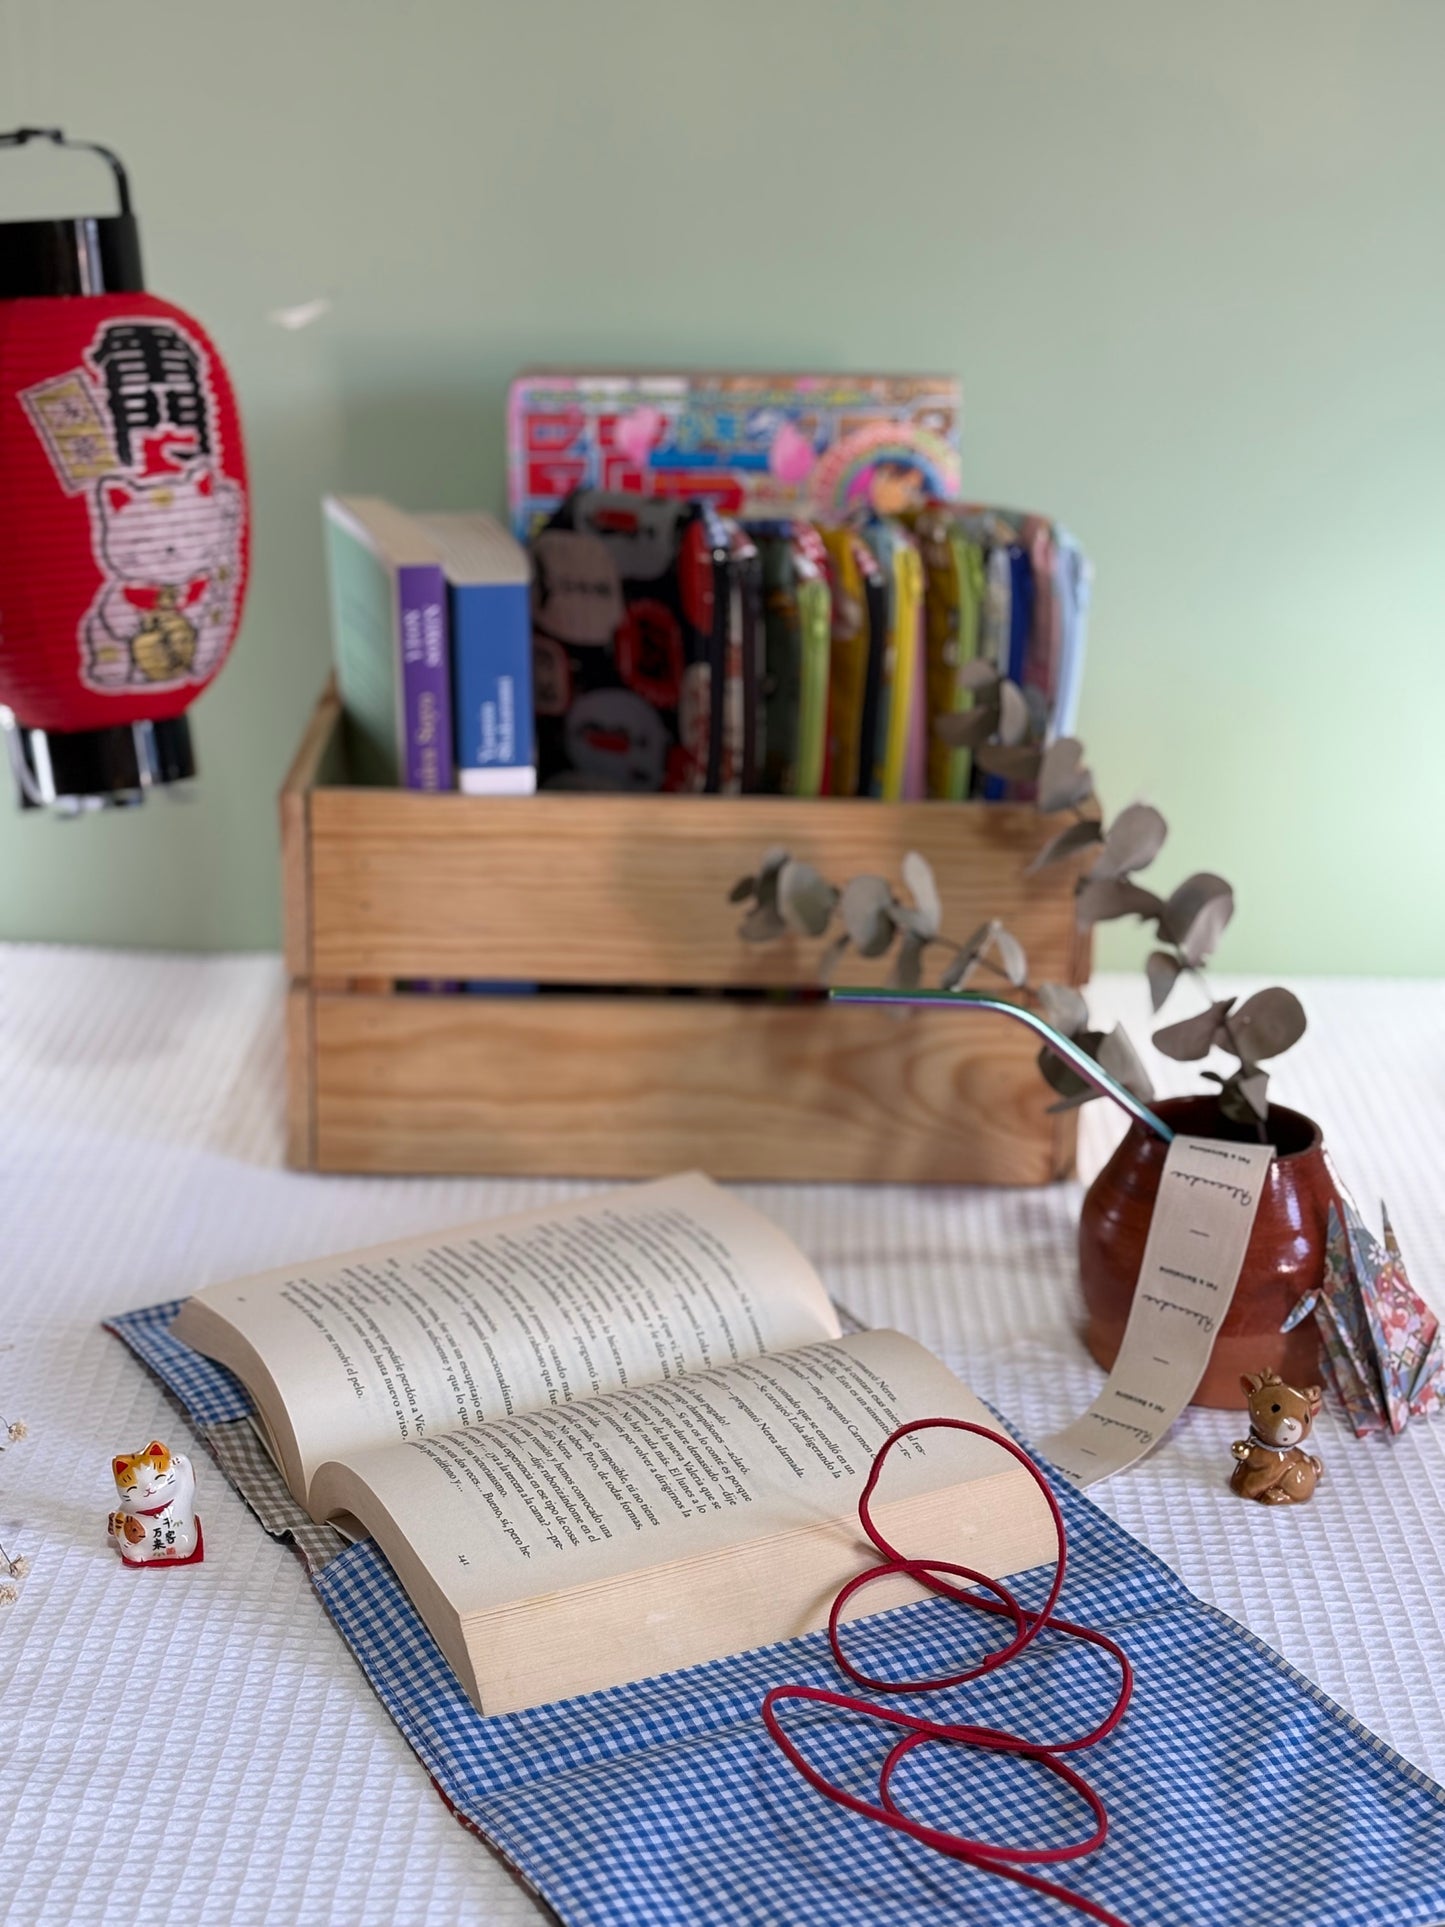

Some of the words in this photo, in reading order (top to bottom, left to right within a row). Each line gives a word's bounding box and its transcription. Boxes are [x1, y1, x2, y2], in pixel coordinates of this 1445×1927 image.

[696, 1331, 709, 1354] Lola
[346, 1367, 358, 1376] el
[528, 1336, 546, 1368] rabioso
[540, 1369, 553, 1387] que
[548, 1389, 558, 1405] fue
[548, 1344, 567, 1379] cuando
[562, 1381, 573, 1402] más
[607, 1335, 622, 1366] hiciera
[618, 1368, 628, 1389] mu-
[661, 1361, 671, 1381] una
[674, 1355, 687, 1377] Tiró
[347, 1376, 364, 1398] pelo.
[446, 1374, 460, 1392] que
[453, 1348, 463, 1360] un
[459, 1361, 480, 1408] escupitajo
[475, 1409, 484, 1423] en
[483, 1342, 514, 1416] emocionadísima
[591, 1380, 602, 1395] in-
[373, 1354, 388, 1376] hasta
[384, 1377, 400, 1407] nuevo
[395, 1410, 408, 1440] aviso.
[381, 1345, 404, 1371] pedirle
[395, 1372, 416, 1405] perdón
[414, 1414, 425, 1436] Víc-
[455, 1393, 465, 1404] lo
[856, 1396, 867, 1406] un
[457, 1406, 470, 1426] que
[682, 1419, 693, 1428] no
[700, 1402, 730, 1426] pegado!
[817, 1395, 850, 1424] preguntó
[847, 1424, 872, 1453] Carmen
[849, 1372, 873, 1394] contara
[871, 1394, 885, 1407] esas
[912, 1442, 925, 1455] res-
[652, 1426, 664, 1434] de
[659, 1433, 670, 1441] la
[686, 1404, 724, 1443] champiñones
[724, 1445, 750, 1475] —aclaró.
[691, 1428, 701, 1437] os
[697, 1436, 708, 1445] lo
[764, 1392, 792, 1417] carcajeó
[787, 1416, 805, 1434] Lola
[801, 1434, 834, 1470] aligerando
[831, 1470, 842, 1479] la
[775, 1385, 800, 1409] contado
[796, 1408, 812, 1421] que
[808, 1421, 818, 1429] se
[815, 1429, 841, 1454] enrolló
[836, 1454, 847, 1464] en
[843, 1464, 855, 1475] un
[660, 1417, 676, 1429] que
[673, 1429, 690, 1444] dure
[686, 1445, 719, 1482] demasiado
[718, 1483, 737, 1505] —dije
[664, 1441, 684, 1461] nueva
[705, 1445, 726, 1465] conté
[757, 1422, 777, 1444] Nerea
[775, 1445, 804, 1478] alarmada.
[472, 1455, 507, 1497] victorianismo.
[598, 1448, 628, 1484] imposible,
[618, 1433, 636, 1444] por
[633, 1445, 653, 1467] volver
[654, 1473, 684, 1509] dirigirnos
[681, 1509, 692, 1518] la
[629, 1420, 643, 1432] hay
[640, 1433, 658, 1450] nada
[654, 1450, 670, 1467] más.
[668, 1467, 682, 1477] El
[675, 1477, 695, 1498] lunes
[696, 1504, 707, 1514] lo
[683, 1461, 704, 1486] Valeria
[721, 1466, 731, 1474] es
[504, 1471, 524, 1493] tercera
[582, 1451, 599, 1471] Pero,
[597, 1471, 609, 1480] de
[604, 1480, 623, 1501] todas
[620, 1501, 642, 1530] formas,
[625, 1483, 638, 1493] tú
[725, 1475, 752, 1501] porque
[523, 1496, 534, 1505] la
[553, 1462, 574, 1485] hemos
[571, 1485, 602, 1523] convocado
[599, 1523, 612, 1538] una
[631, 1493, 644, 1503] no
[699, 1486, 715, 1501] que
[482, 1492, 502, 1518] Bueno,
[528, 1504, 551, 1526] cama?
[529, 1480, 540, 1489] en
[536, 1489, 548, 1500] ese
[544, 1499, 559, 1515] tipo
[555, 1515, 567, 1525] de
[562, 1525, 580, 1546] cosas.
[541, 1470, 583, 1523] ruborizándome
[580, 1524, 591, 1534] en
[587, 1534, 601, 1543] el
[640, 1503, 660, 1526] tienes
[711, 1501, 722, 1509] se
[499, 1518, 513, 1528] sí,
[503, 1527, 523, 1545] pero
[457, 1554, 471, 1567] 241
[519, 1544, 530, 1558] he-
